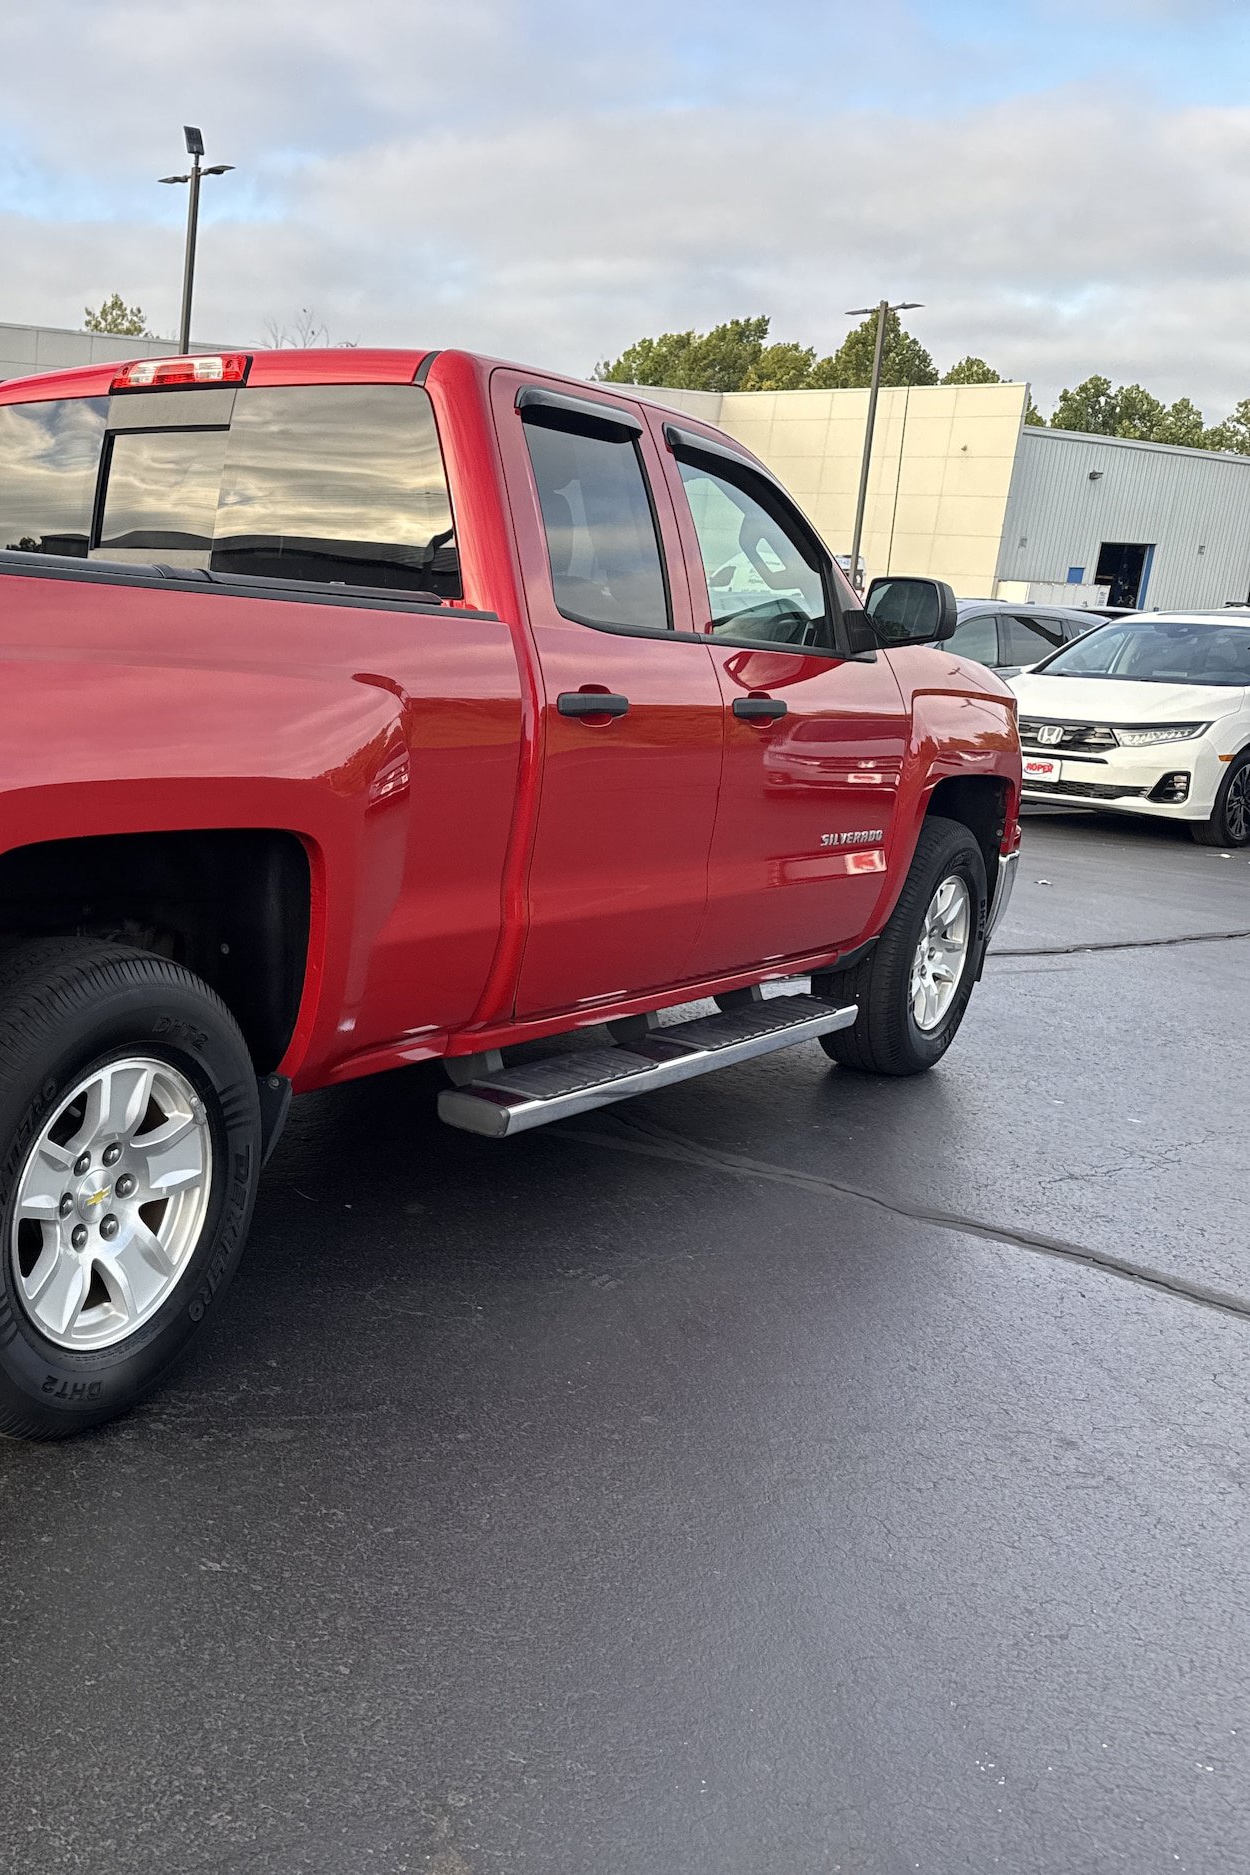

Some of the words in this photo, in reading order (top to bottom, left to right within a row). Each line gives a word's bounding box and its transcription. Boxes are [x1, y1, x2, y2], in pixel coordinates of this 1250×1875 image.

[1026, 762, 1054, 774] ROPER
[820, 829, 883, 847] SILVERADO
[41, 1375, 103, 1400] DHT2
